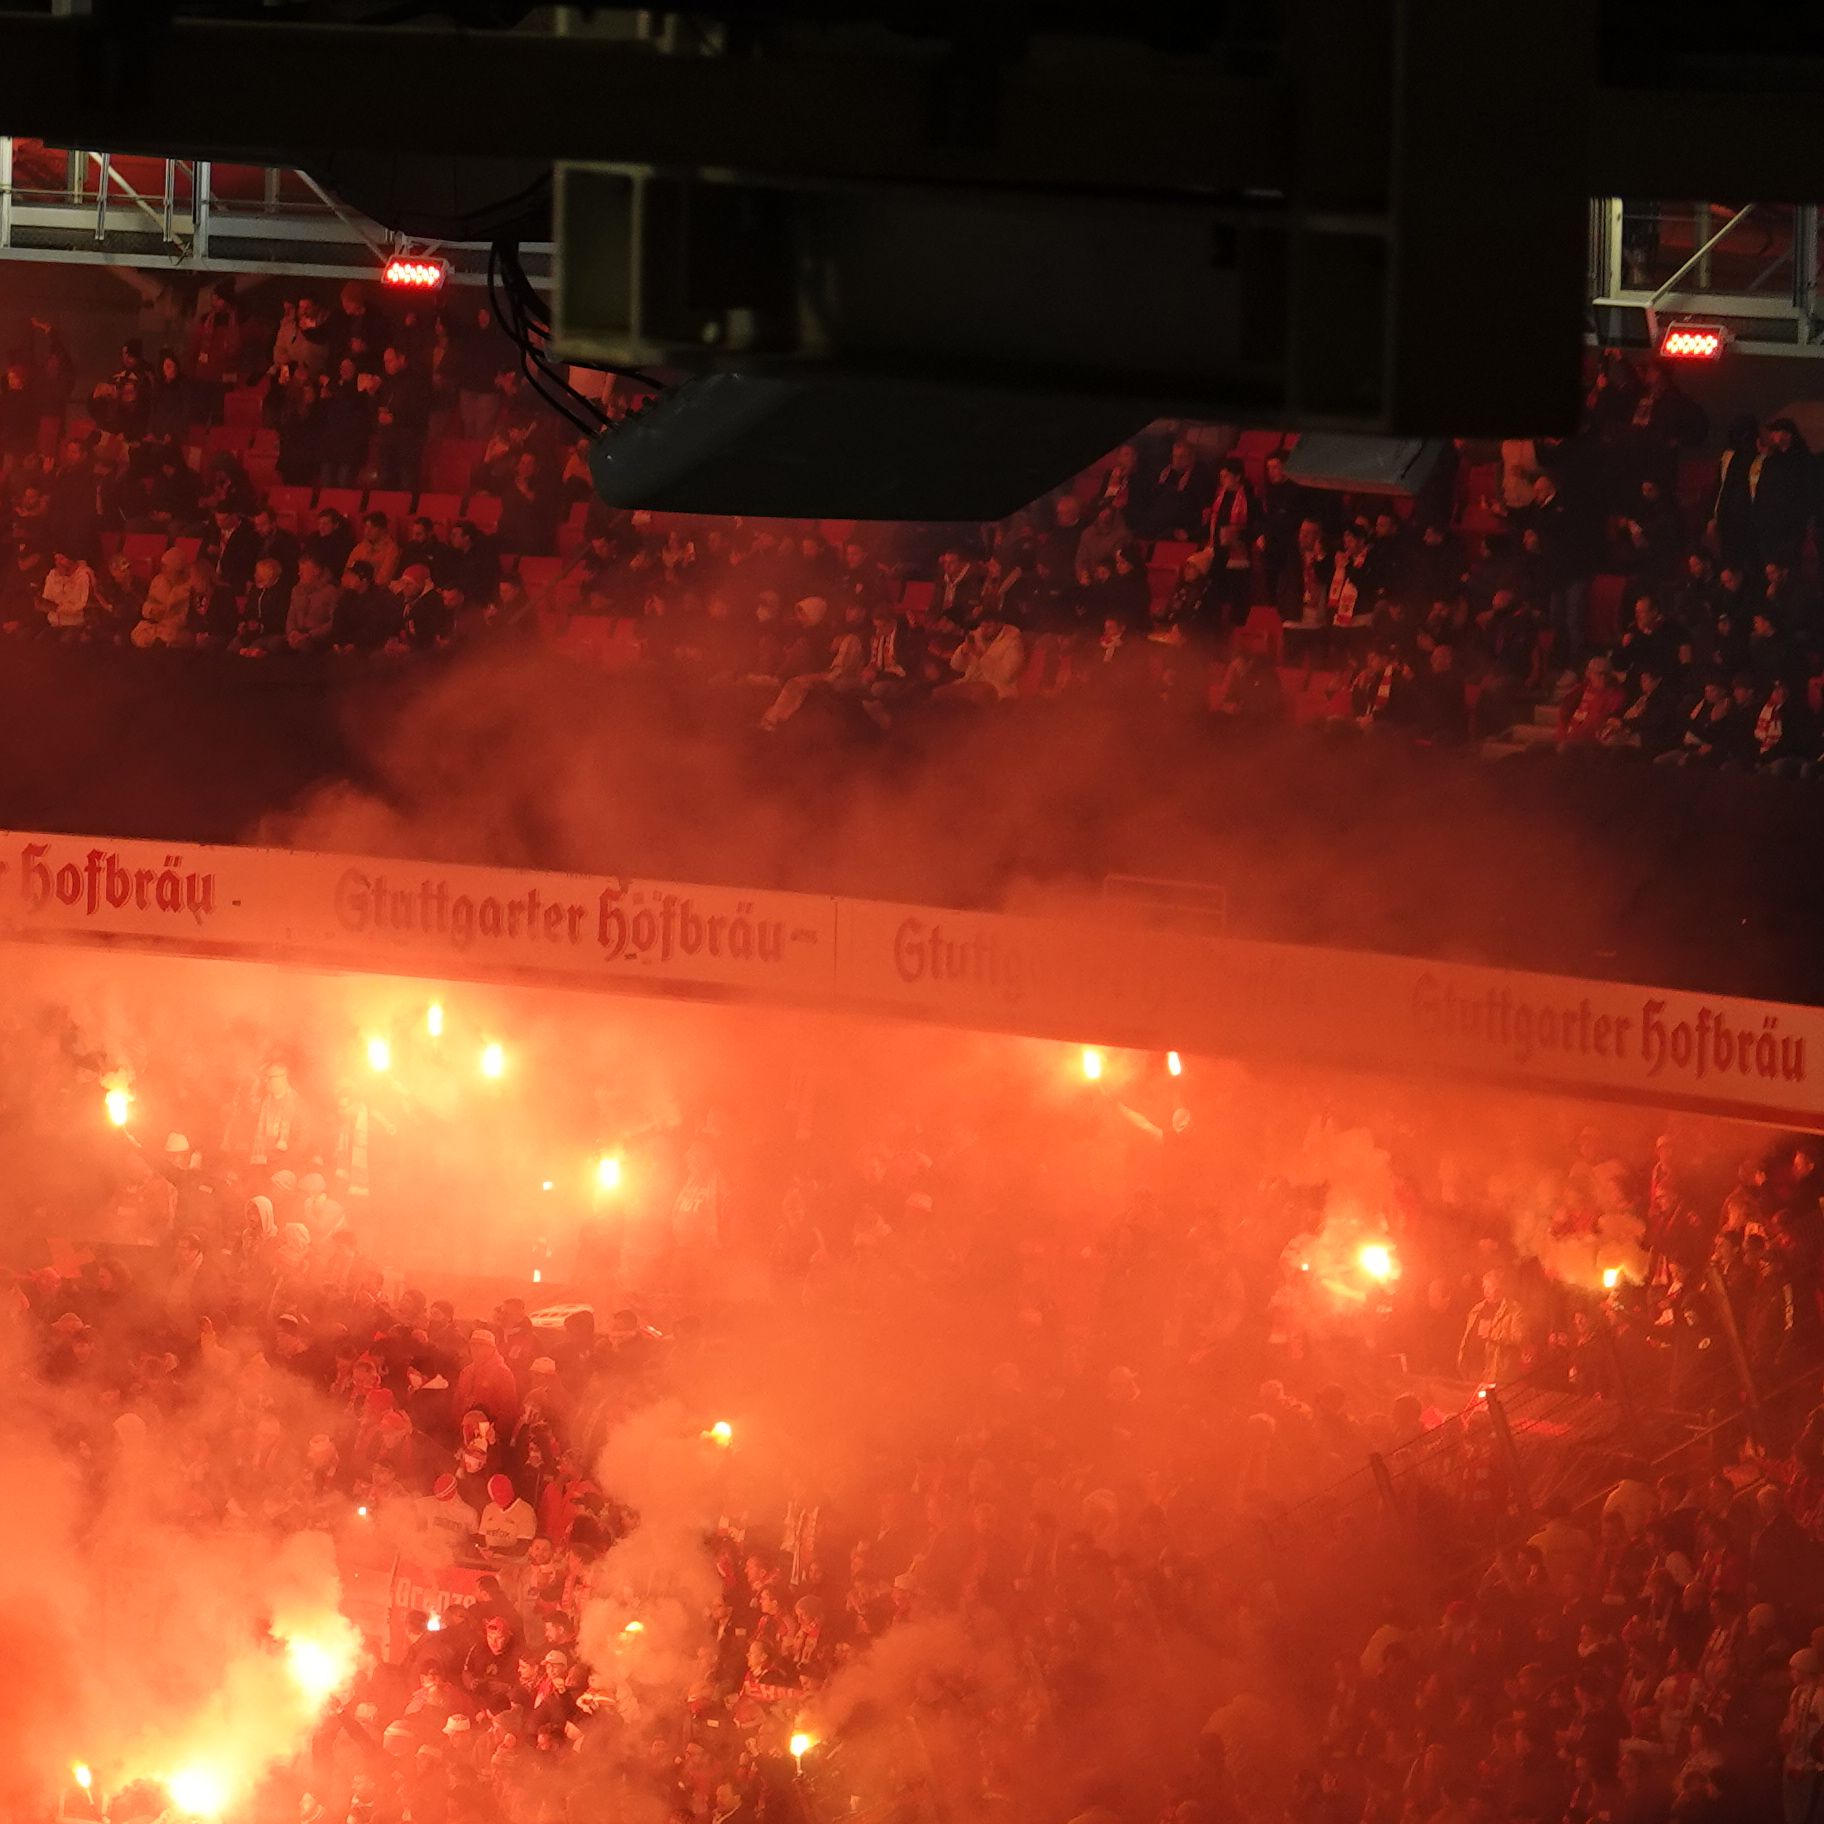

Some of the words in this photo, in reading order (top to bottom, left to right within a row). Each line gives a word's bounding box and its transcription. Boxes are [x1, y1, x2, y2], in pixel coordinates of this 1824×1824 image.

[20, 842, 218, 918] Hofbräu
[335, 870, 584, 952] Stuttgarter
[597, 880, 785, 966] Hofbräu
[1639, 990, 1807, 1086] Hofbräu
